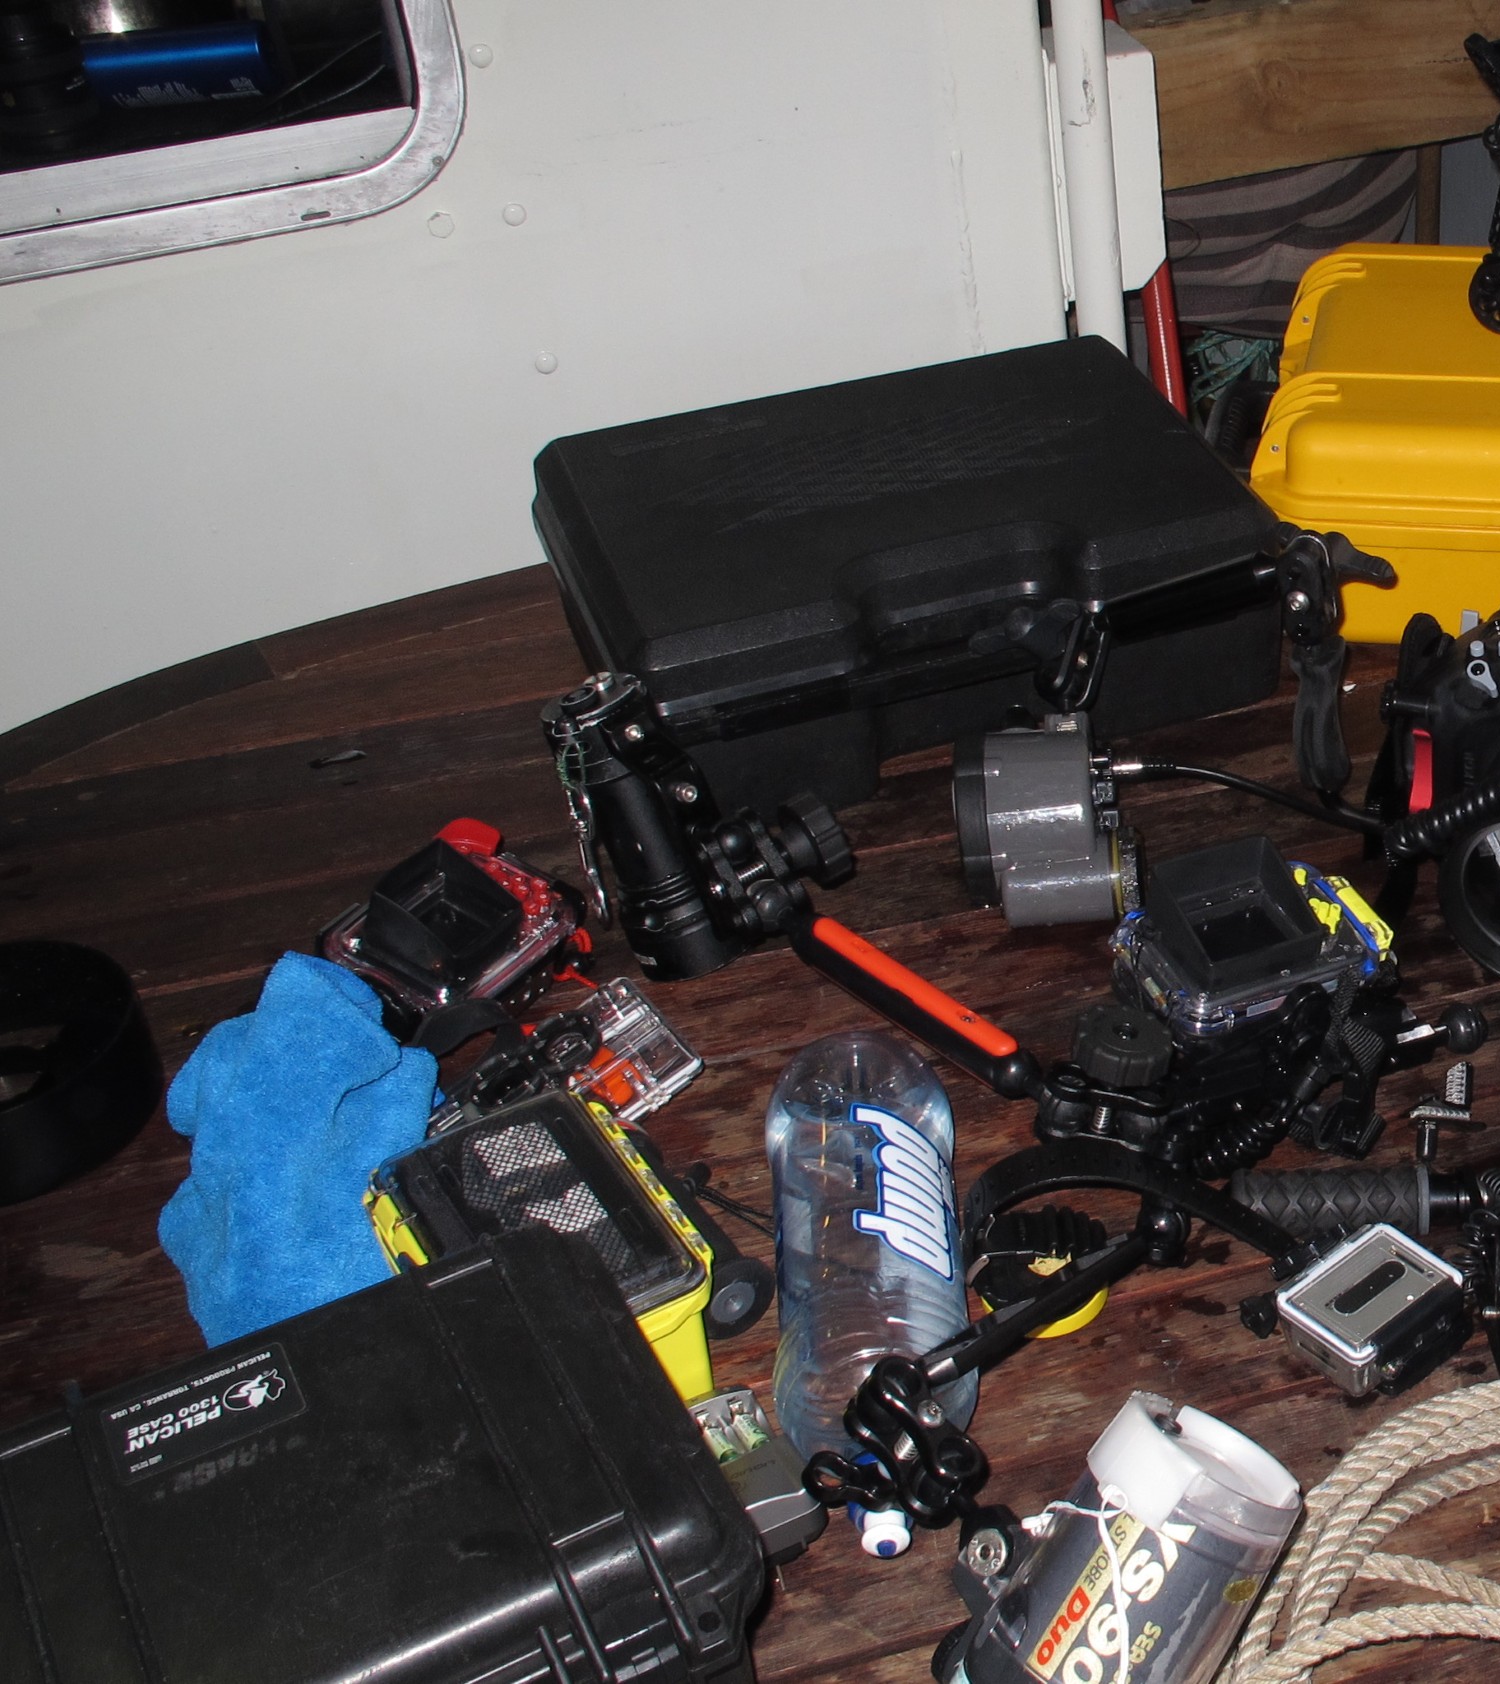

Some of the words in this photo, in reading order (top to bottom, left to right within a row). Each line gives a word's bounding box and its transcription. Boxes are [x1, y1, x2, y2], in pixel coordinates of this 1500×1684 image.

[851, 1104, 953, 1282] pump
[237, 1351, 271, 1370] PELICAN
[110, 1409, 128, 1420] USA
[130, 1402, 141, 1413] CA
[178, 1394, 220, 1418] 1300
[127, 1412, 174, 1439] CASE
[128, 1405, 221, 1453] PELICAN
[1084, 1525, 1127, 1591] STOBE
[1037, 1586, 1090, 1666] Duo
